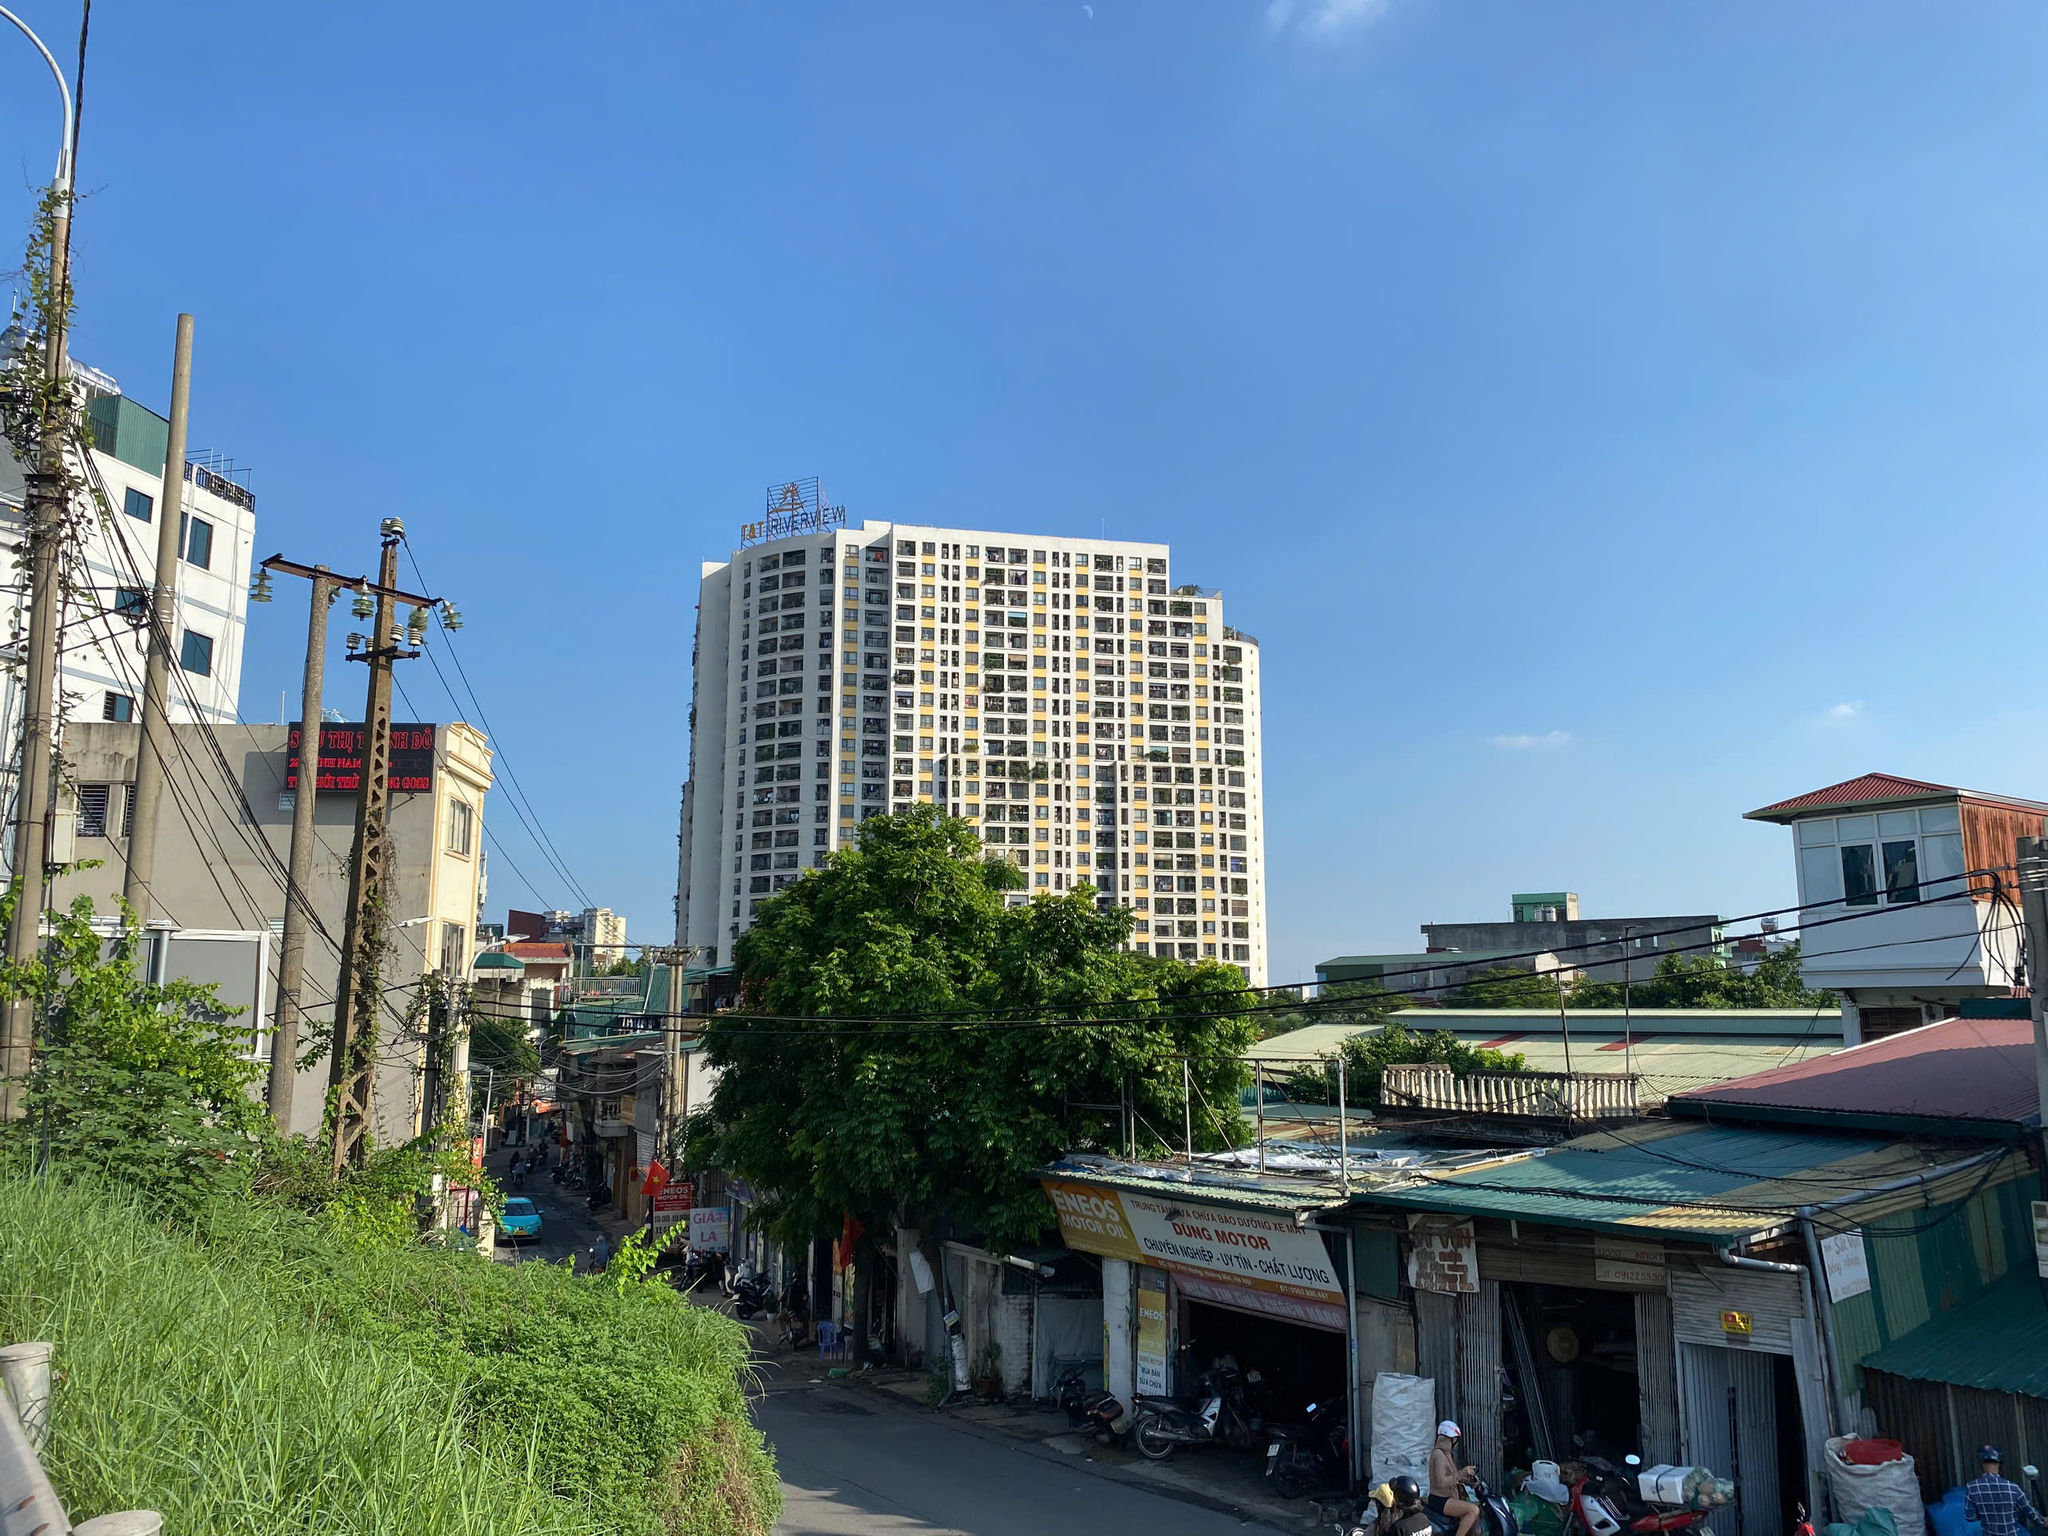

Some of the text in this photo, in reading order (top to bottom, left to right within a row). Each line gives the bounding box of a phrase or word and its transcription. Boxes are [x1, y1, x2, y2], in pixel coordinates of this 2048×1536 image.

[741, 503, 846, 541] T&T RIVERVIEW
[1050, 1188, 1120, 1222] ENEOS
[1129, 1199, 1157, 1213] TRUNG
[1272, 1221, 1286, 1233] XE
[1061, 1213, 1128, 1240] MOTOR OIL
[1214, 1229, 1271, 1251] MOTOR
[1179, 1245, 1214, 1265] NGHIỆP
[1219, 1252, 1234, 1268] UY
[1258, 1256, 1287, 1277] CHẤT
[1287, 1263, 1330, 1285] LƯỢNG
[1139, 1307, 1165, 1321] ENEOS
